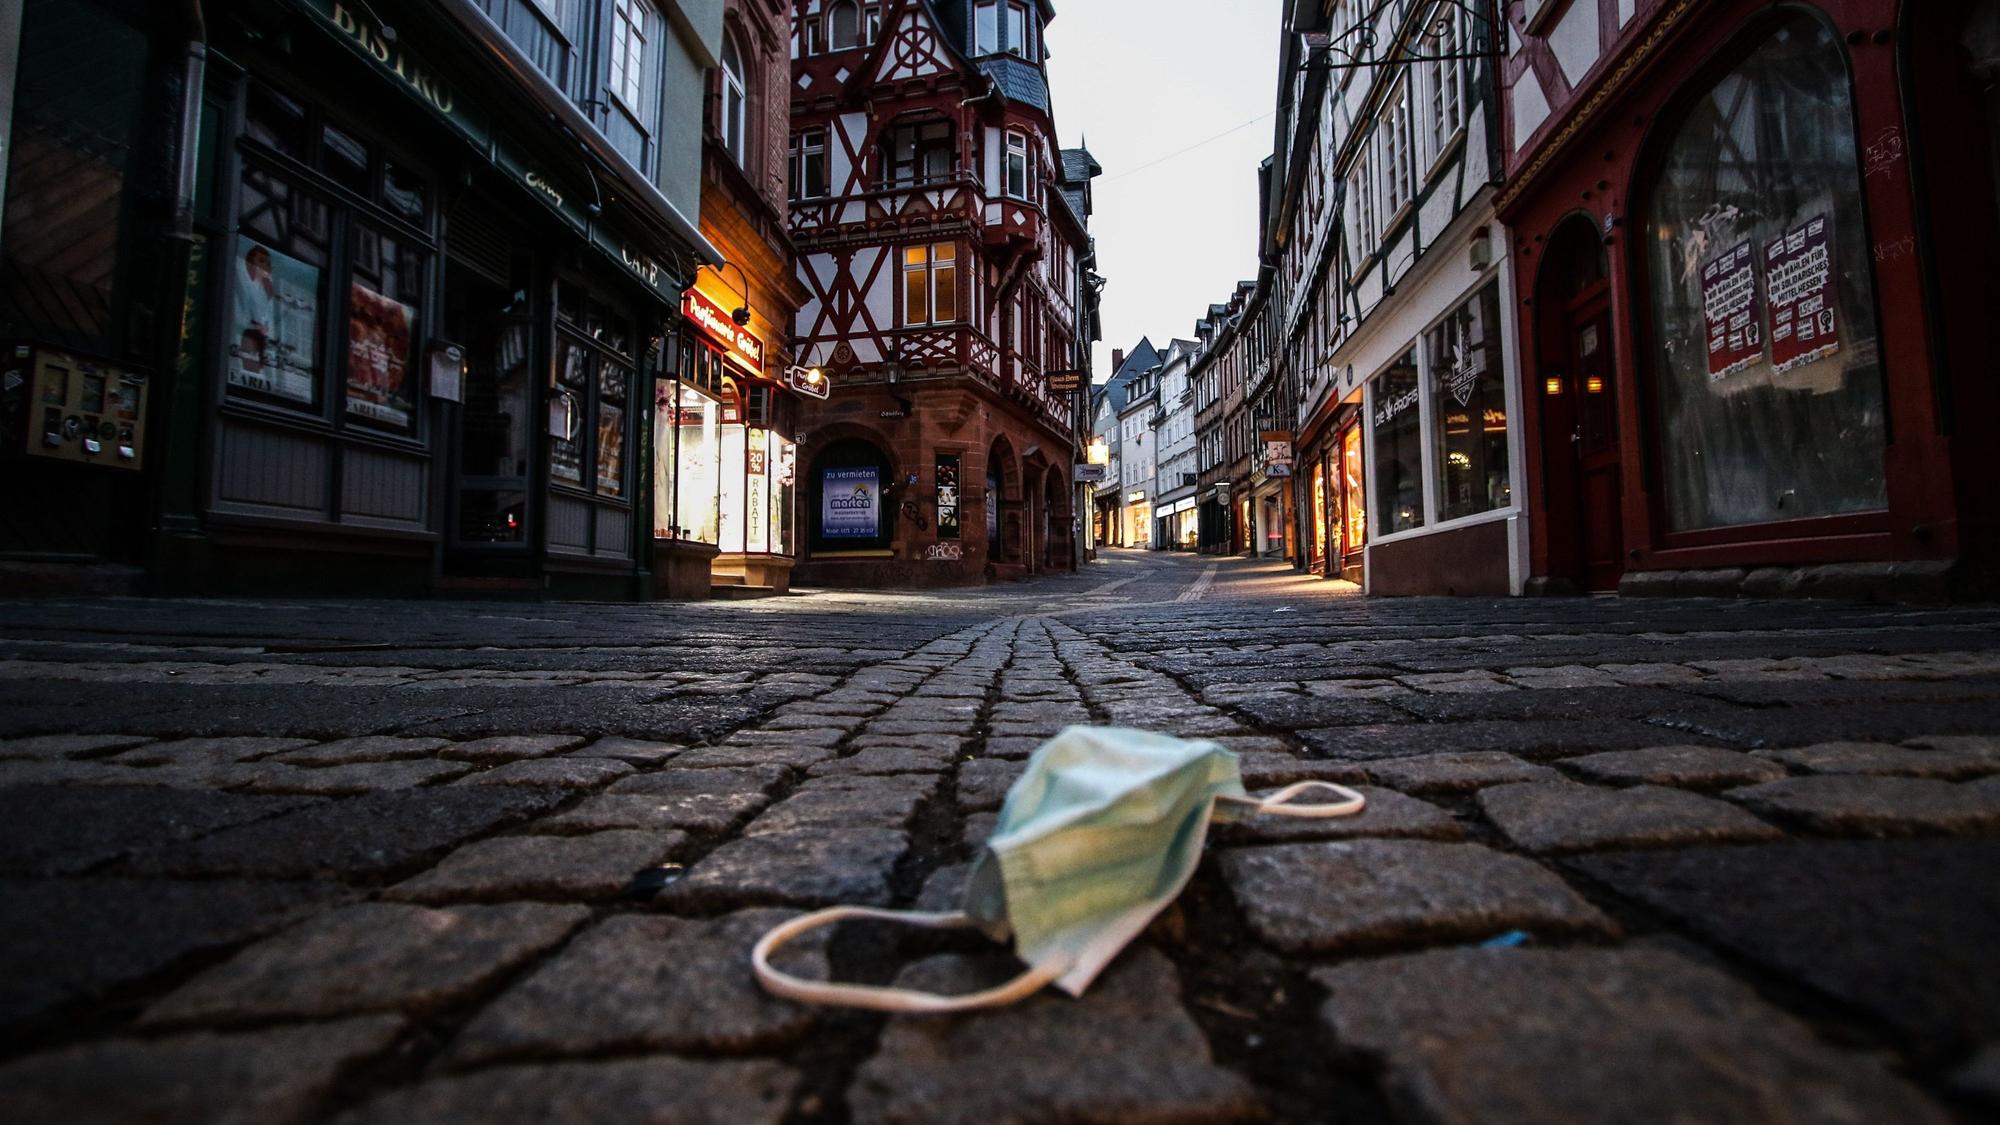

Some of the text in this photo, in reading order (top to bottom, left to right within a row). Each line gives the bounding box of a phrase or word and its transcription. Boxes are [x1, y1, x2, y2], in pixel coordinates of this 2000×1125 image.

[1781, 259, 1827, 290] SOLIDARISCHES
[1777, 275, 1822, 303] MITTELHESSEN
[1375, 387, 1419, 427] DIE PROFIS
[750, 452, 763, 463] 20
[751, 462, 761, 473] %
[837, 470, 876, 479] vermieten
[751, 478, 759, 536] RABATT
[831, 496, 871, 509] marten
